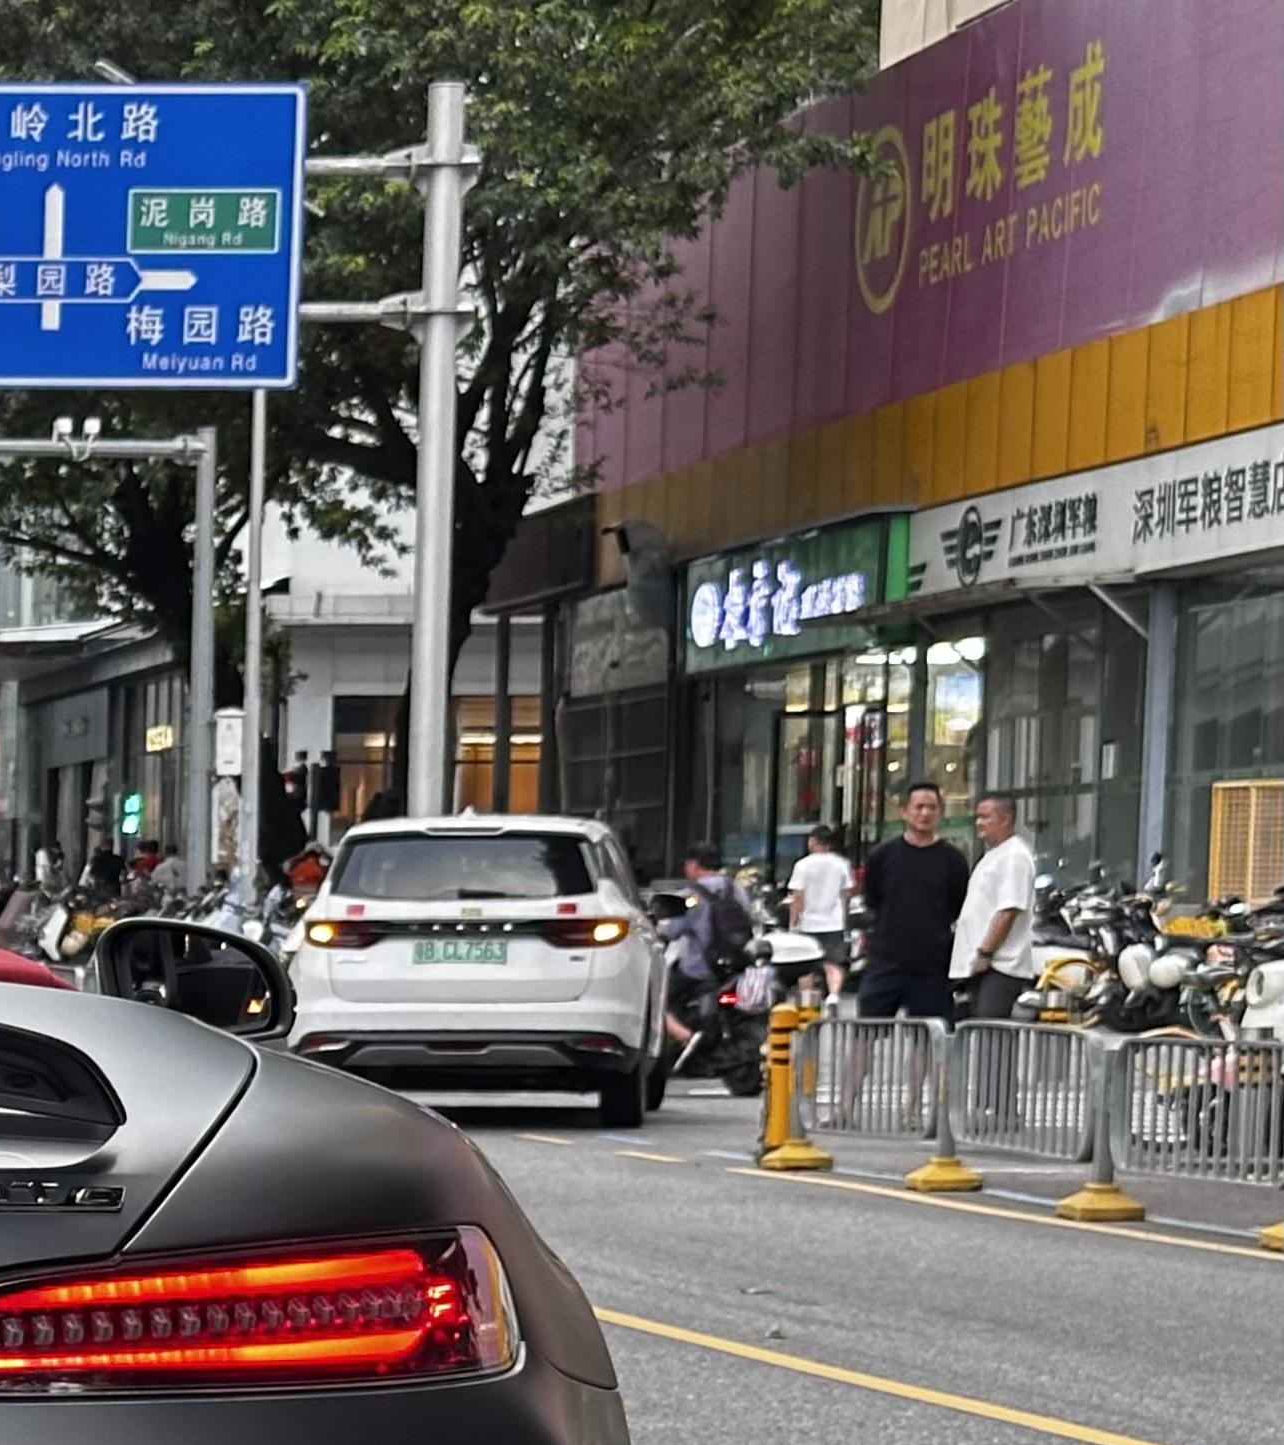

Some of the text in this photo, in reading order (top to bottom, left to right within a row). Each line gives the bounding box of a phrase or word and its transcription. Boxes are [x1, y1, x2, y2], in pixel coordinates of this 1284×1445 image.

[921, 39, 1105, 223] 明珠藝成
[57, 150, 110, 168] North
[120, 150, 146, 168] Rd
[140, 197, 267, 228] 泥岗路
[163, 232, 242, 247] Nigang Rd
[918, 182, 1101, 289] PEARL ART PACIFIC
[126, 306, 274, 347] 梅园路
[142, 353, 257, 374] Meiyuan Rd
[1009, 493, 1097, 552] 广东深圳军粮
